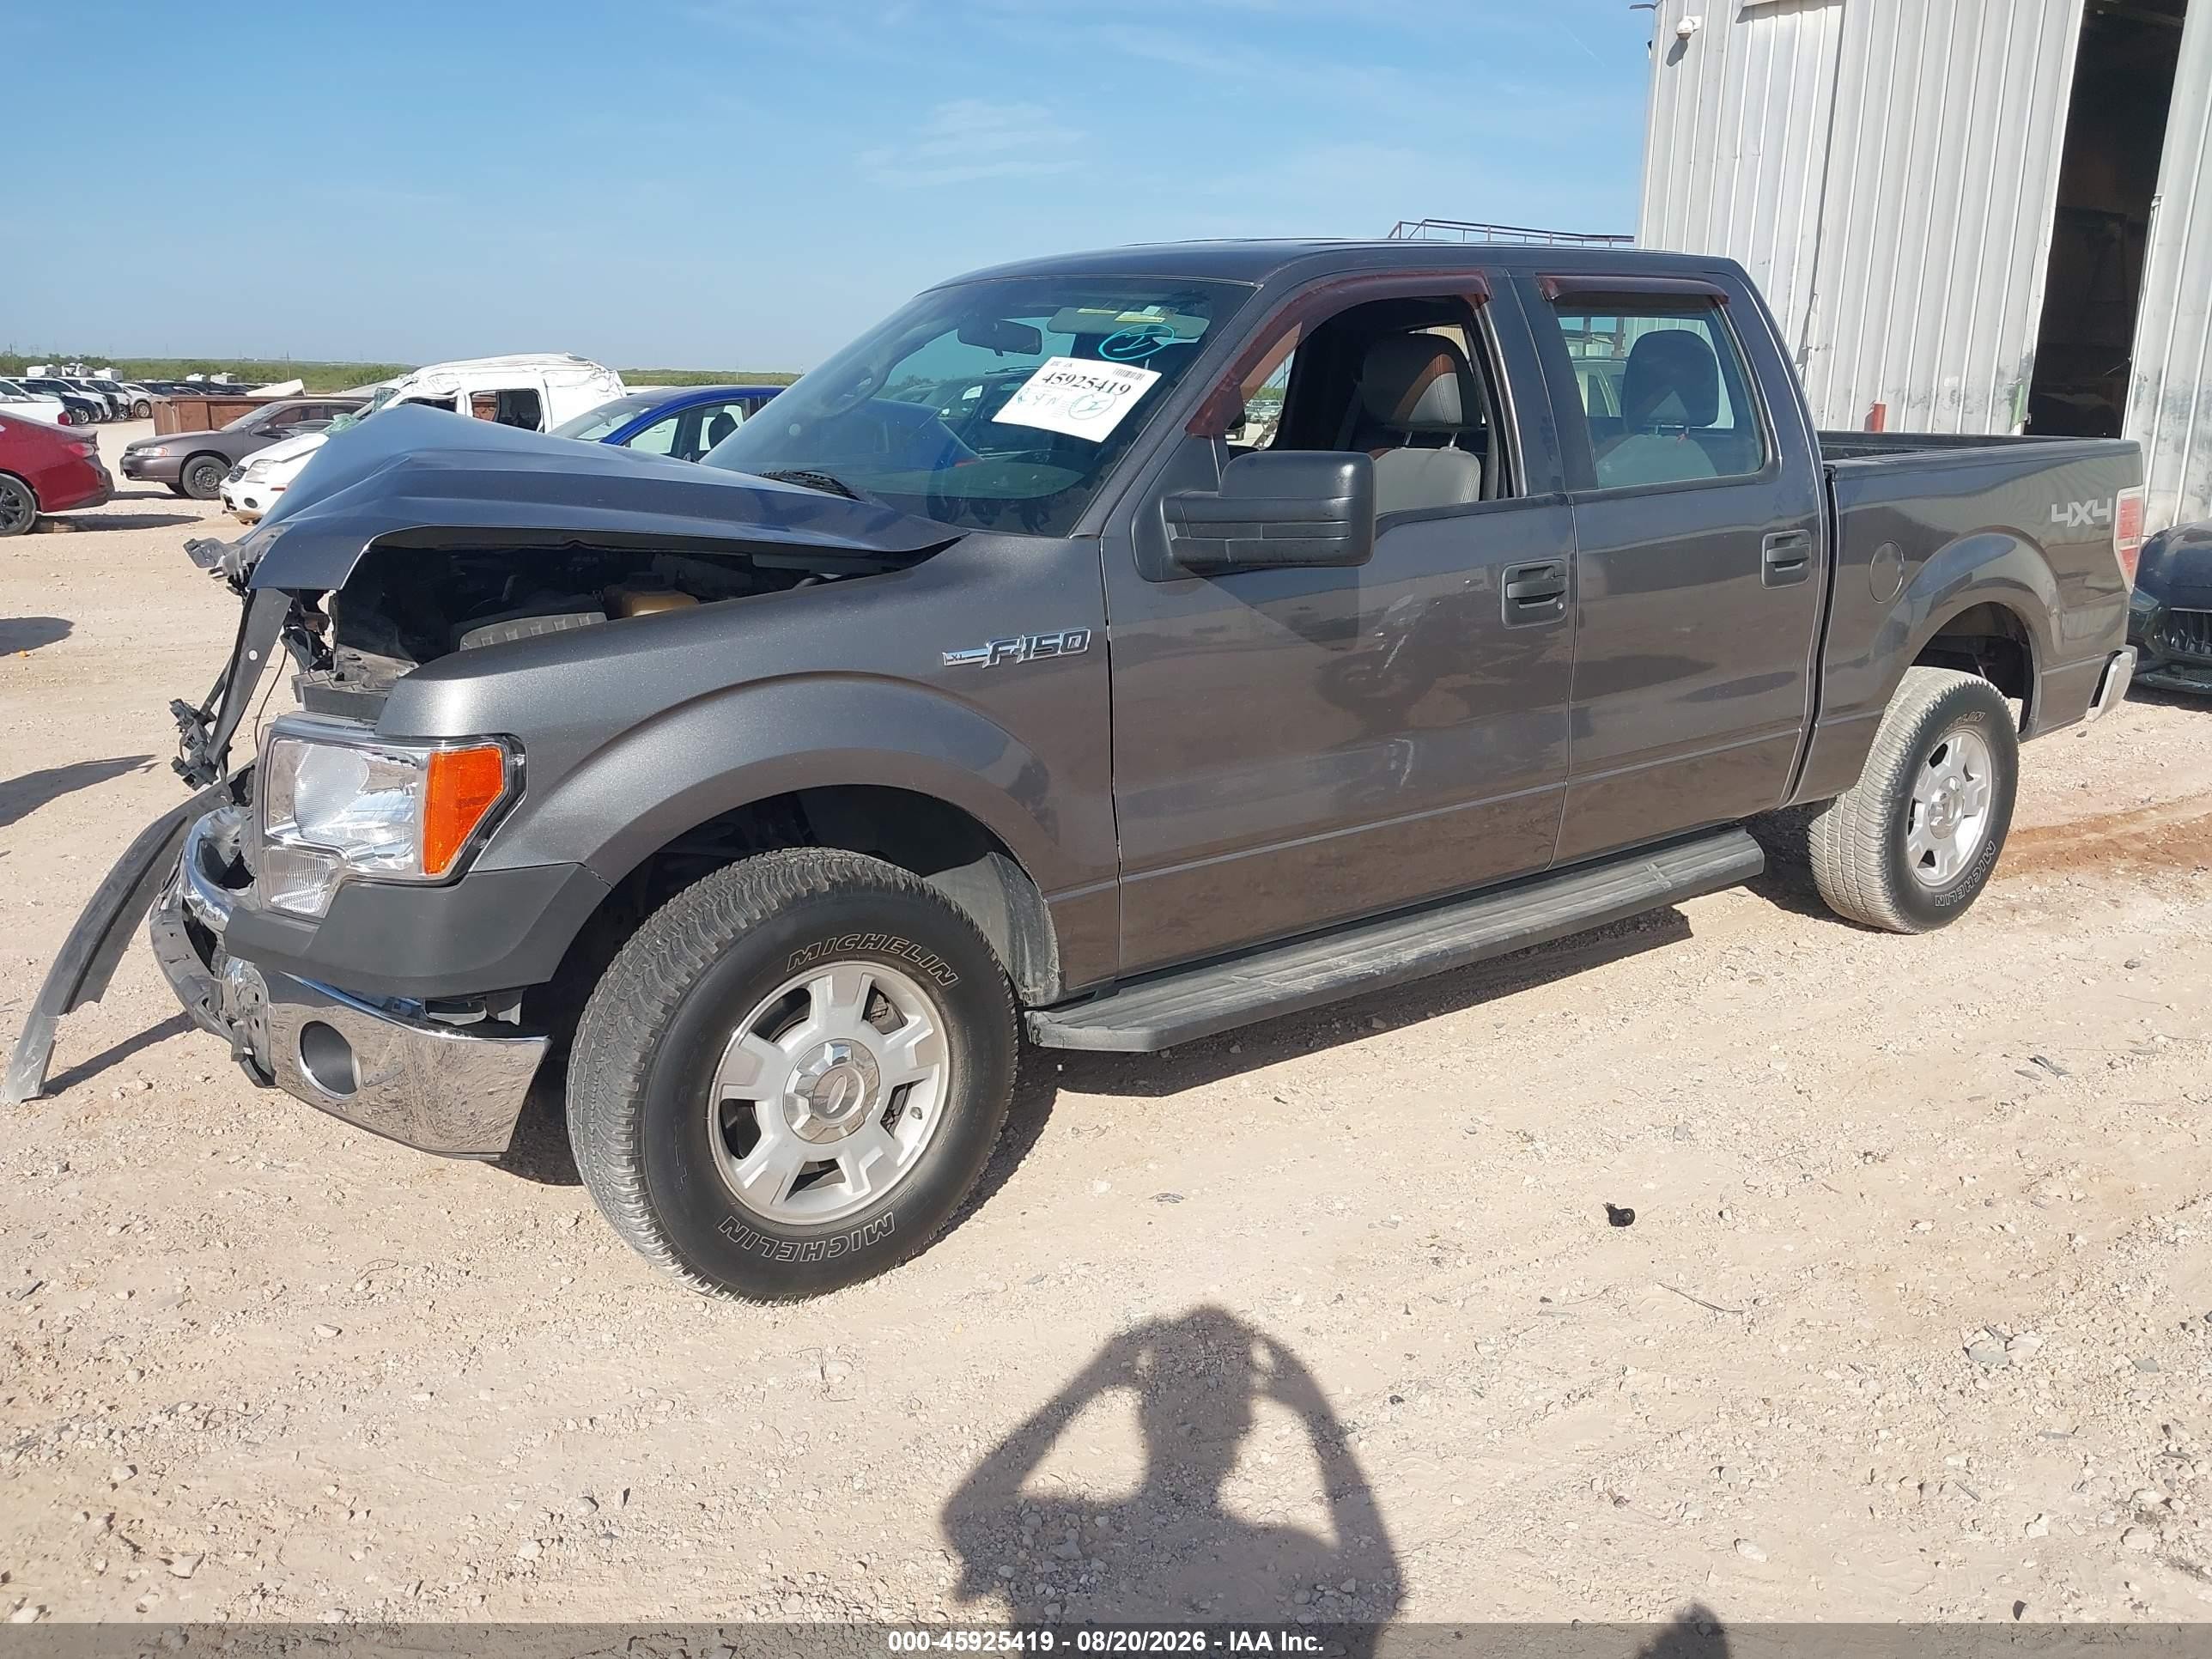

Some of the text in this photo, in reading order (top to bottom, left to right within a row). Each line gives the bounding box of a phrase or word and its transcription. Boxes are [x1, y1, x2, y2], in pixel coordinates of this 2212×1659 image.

[1042, 371, 1132, 396] 45925419
[1934, 840, 1996, 907] MICHELIN
[786, 933, 959, 987] MICHELIN
[714, 1211, 896, 1263] MICHELIN
